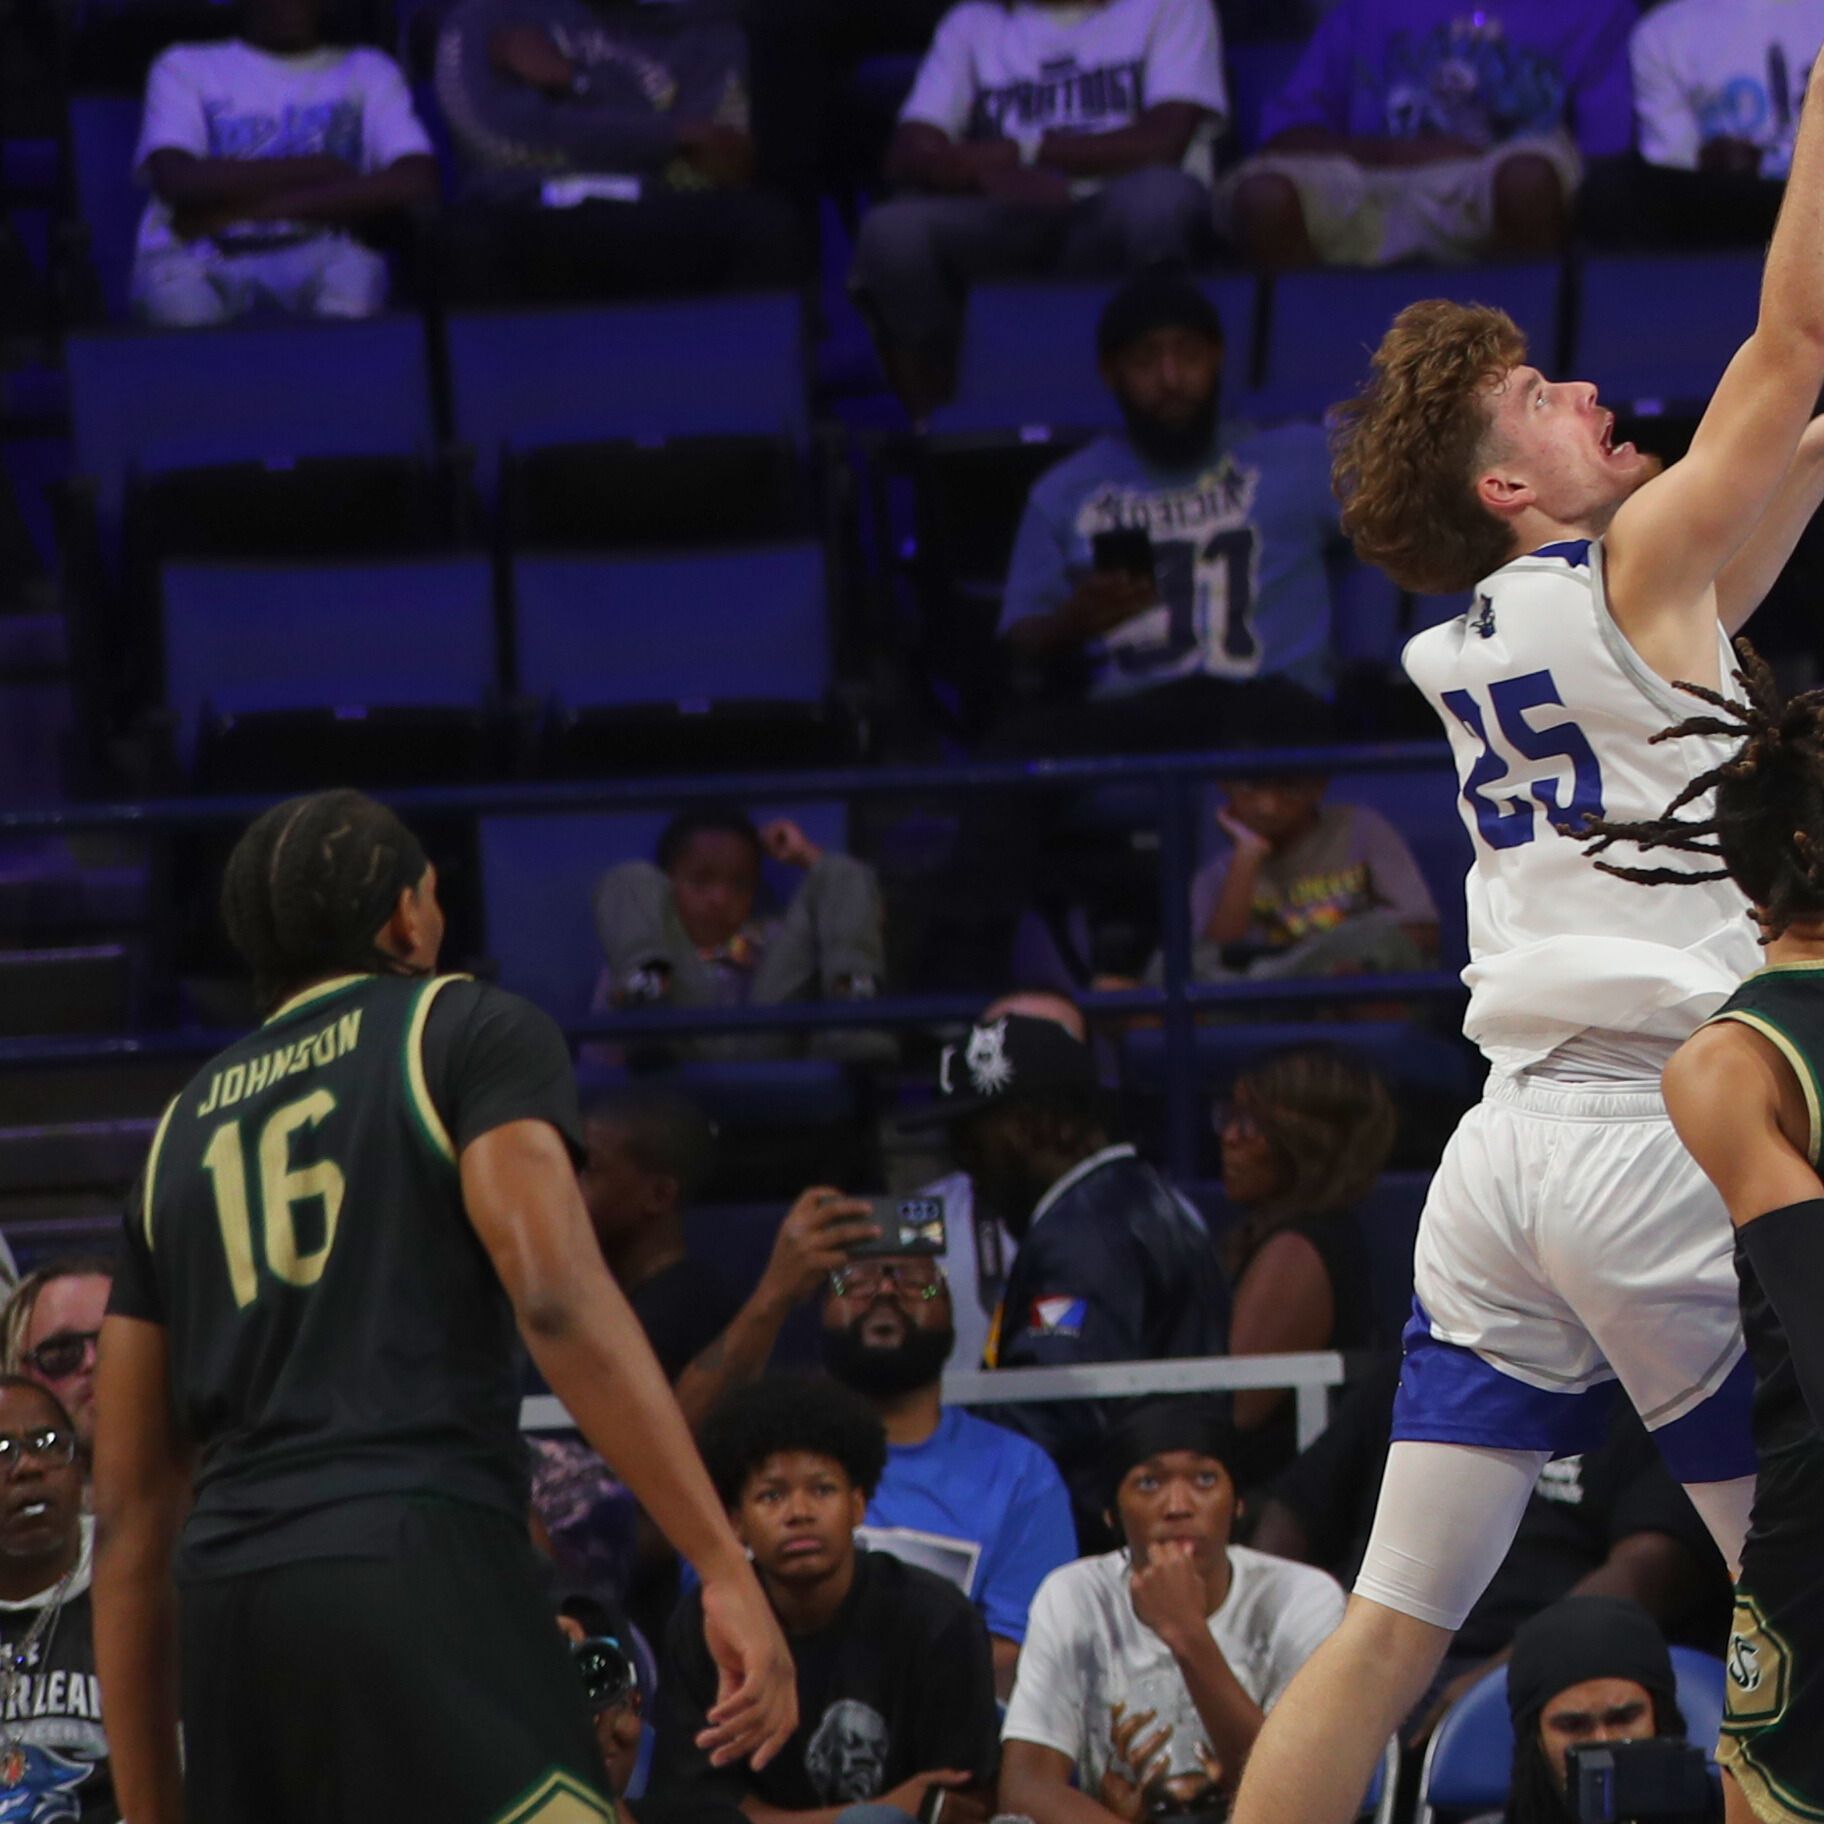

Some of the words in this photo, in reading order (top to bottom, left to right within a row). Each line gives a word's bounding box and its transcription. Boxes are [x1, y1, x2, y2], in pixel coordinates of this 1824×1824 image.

[1440, 668, 1607, 852] 25
[196, 1007, 364, 1119] JOHNSON
[202, 1081, 346, 1311] 16
